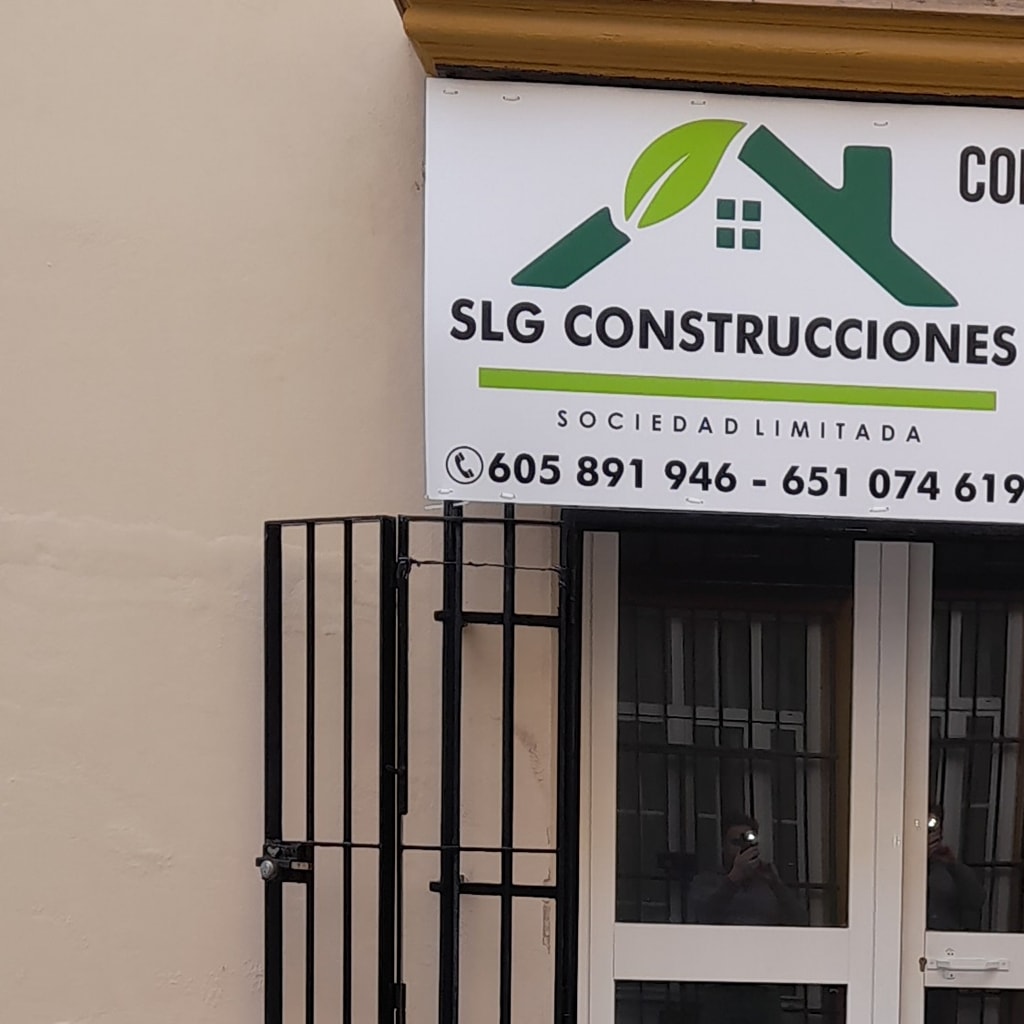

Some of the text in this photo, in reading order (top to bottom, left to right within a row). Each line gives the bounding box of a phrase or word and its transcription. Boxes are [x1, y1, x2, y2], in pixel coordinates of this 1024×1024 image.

[450, 298, 1017, 367] SLG CONSTRUCCIONES
[557, 409, 921, 443] SOCIEDAD LIMITADA
[488, 452, 561, 485] 605
[576, 455, 643, 489] 891
[664, 460, 737, 493] 946
[782, 465, 848, 497] 651
[868, 468, 940, 501] 074
